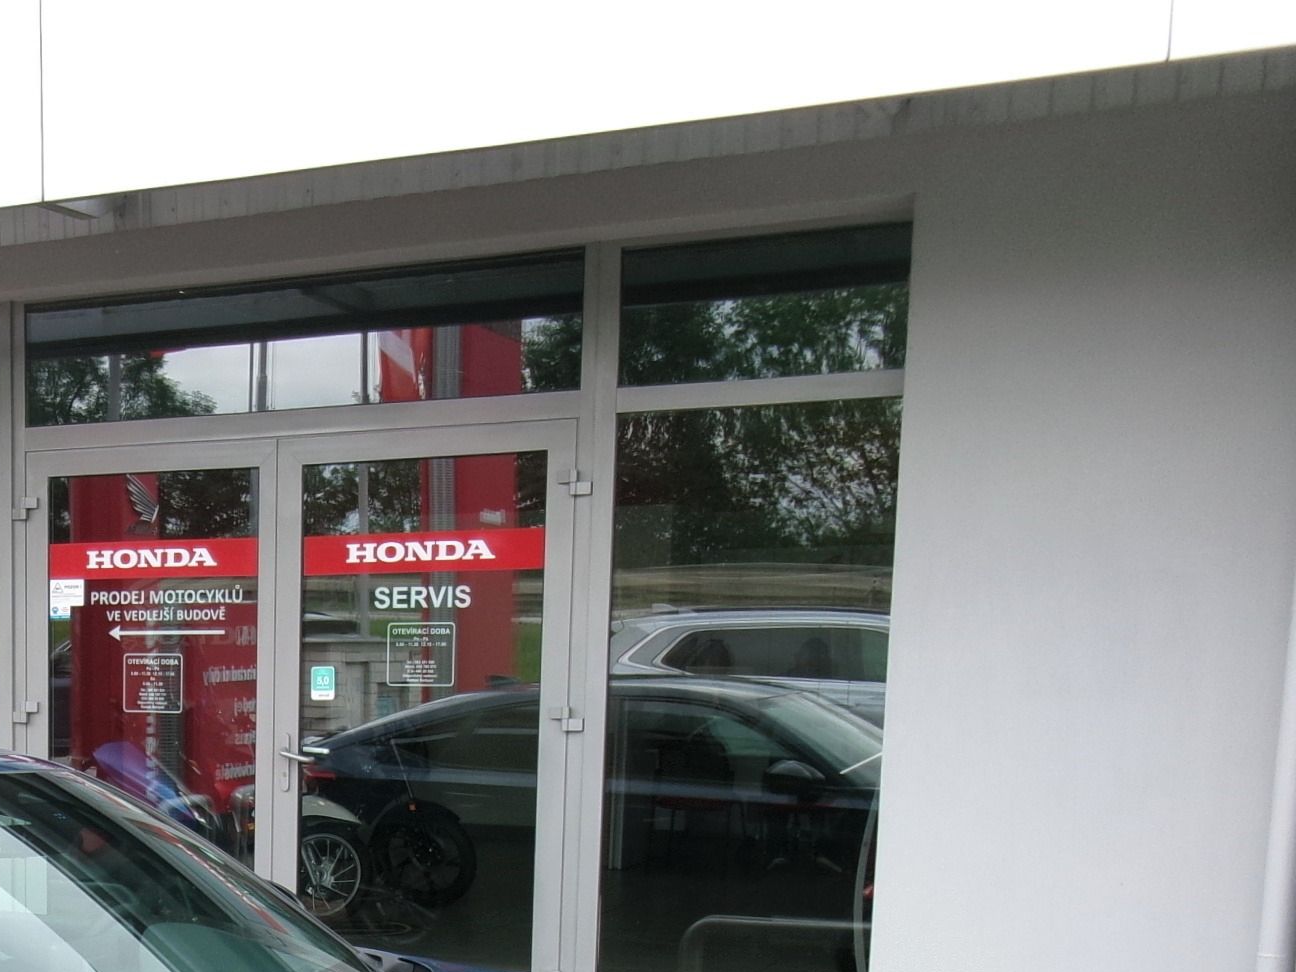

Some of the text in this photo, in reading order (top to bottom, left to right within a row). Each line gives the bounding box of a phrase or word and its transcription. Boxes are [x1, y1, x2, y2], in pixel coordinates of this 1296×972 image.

[86, 548, 218, 569] HONDA
[346, 540, 496, 563] HONDA
[91, 585, 243, 605] PRODEJ MOTOCYKLŮ
[374, 585, 472, 609] SERVIS
[107, 606, 226, 622] VE VEDLEJŠÍ BUDOVĚ
[392, 627, 429, 635] OTEVÍRACÍ
